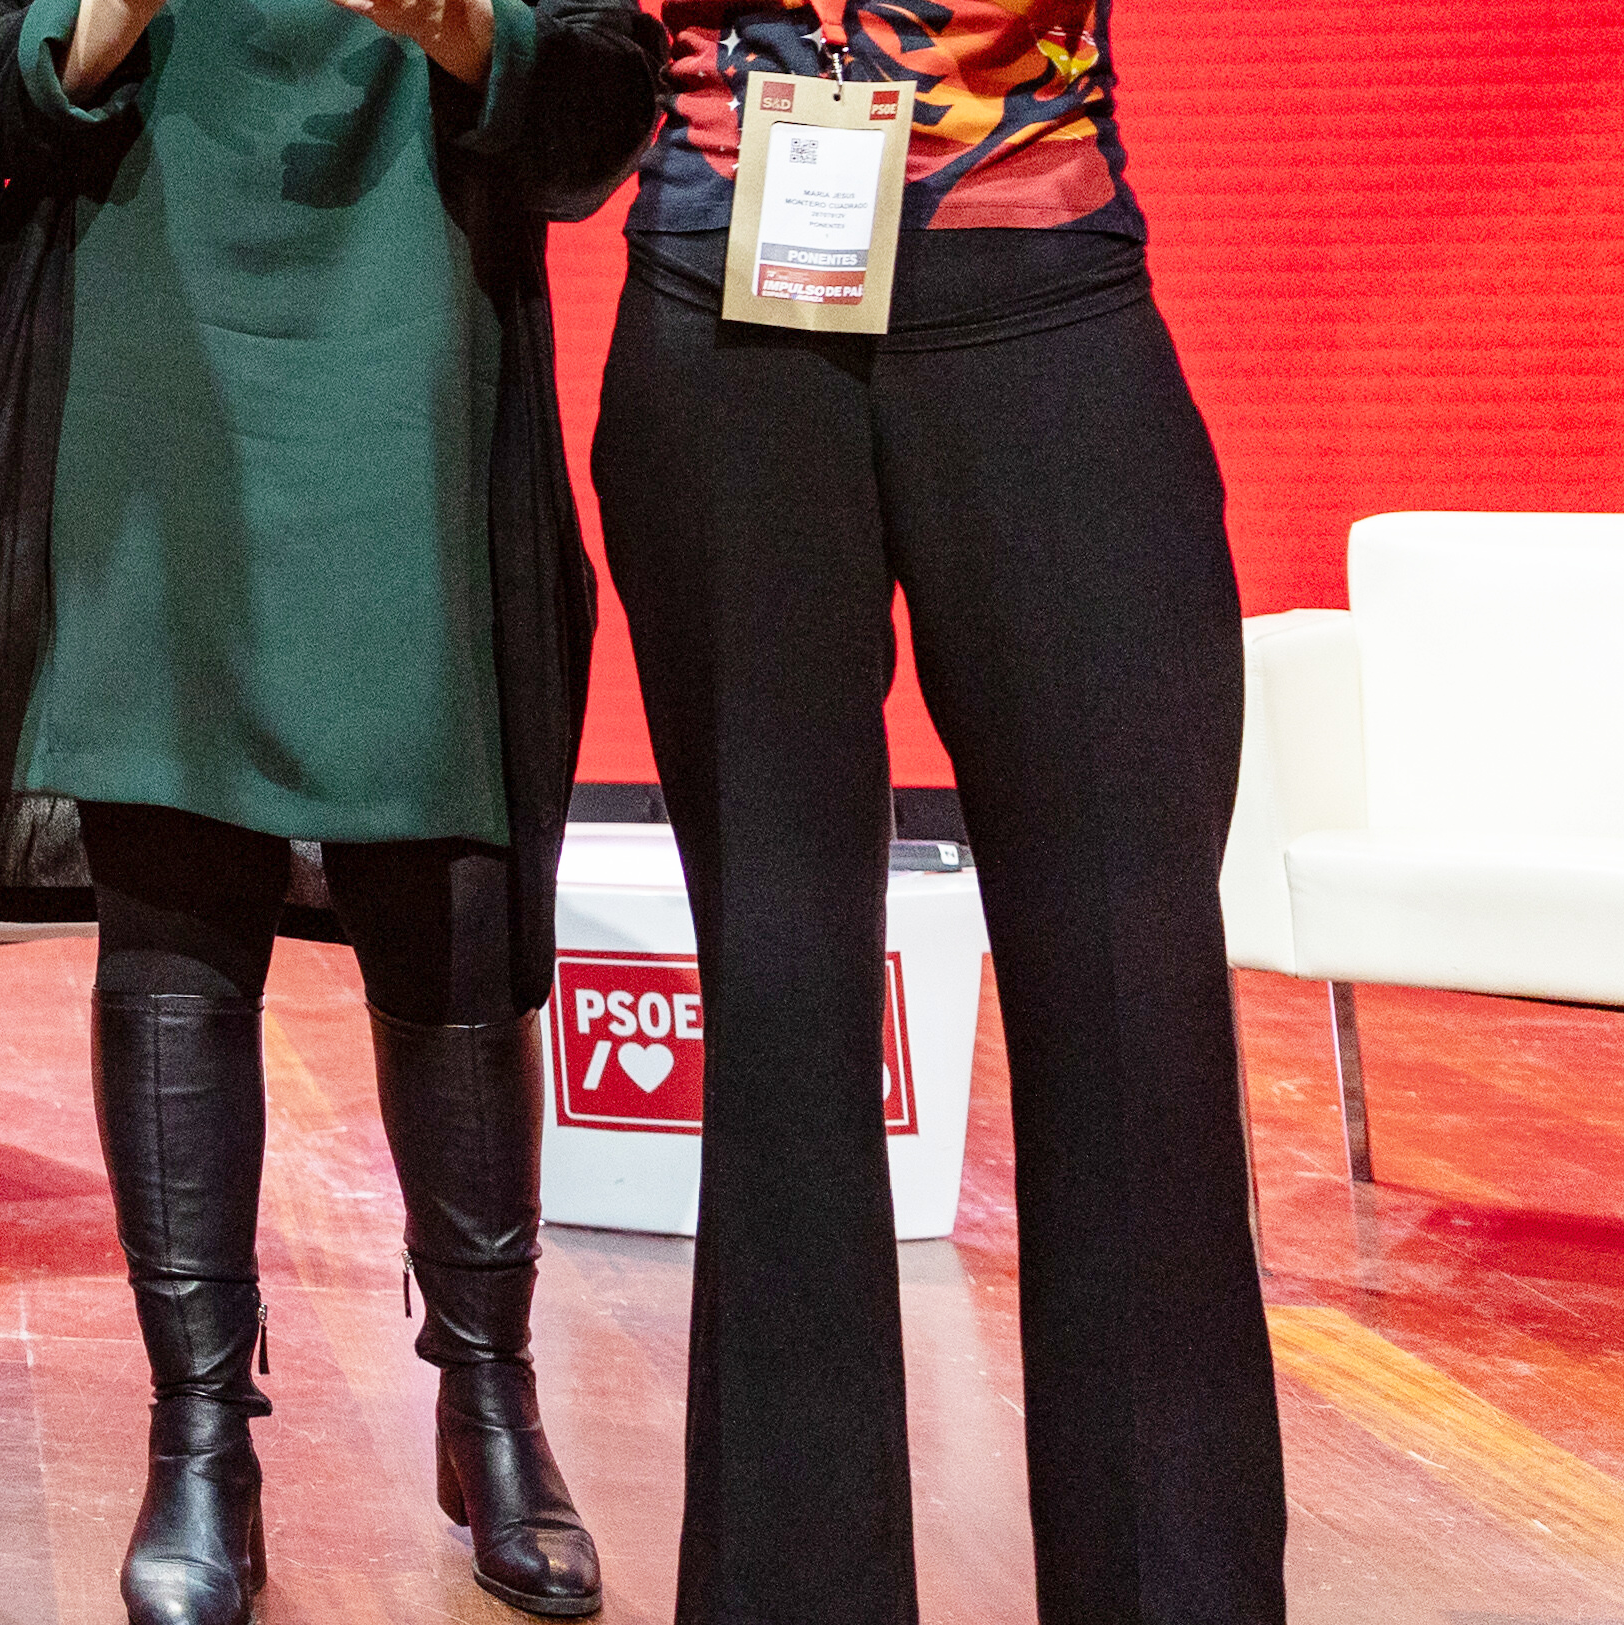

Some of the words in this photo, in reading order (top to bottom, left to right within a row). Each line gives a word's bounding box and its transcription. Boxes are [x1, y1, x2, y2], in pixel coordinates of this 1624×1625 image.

[762, 96, 791, 110] S&D
[871, 103, 896, 115] PSOE
[788, 250, 858, 265] PONENTES
[763, 280, 825, 296] IMPULSO
[825, 285, 842, 296] DE
[574, 988, 704, 1040] PSOE
